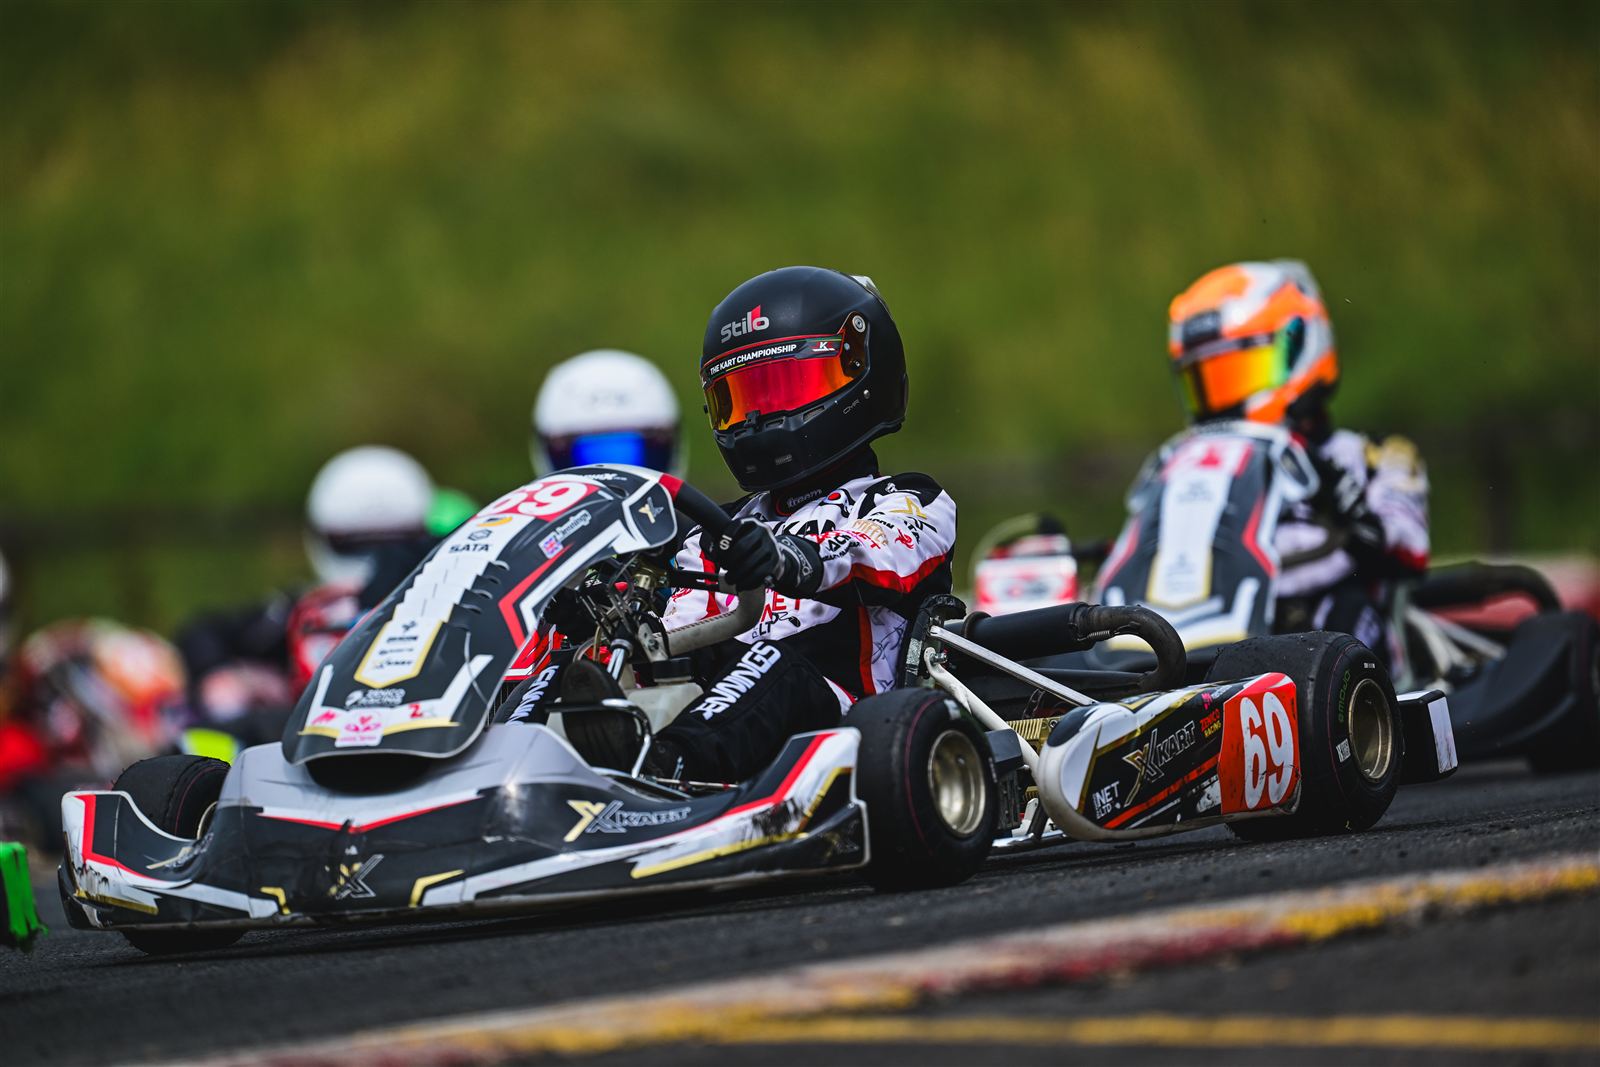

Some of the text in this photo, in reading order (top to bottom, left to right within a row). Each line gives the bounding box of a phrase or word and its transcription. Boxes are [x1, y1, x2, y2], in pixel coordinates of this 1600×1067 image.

[721, 305, 770, 344] Stilo
[710, 344, 797, 375] THE KART CHAMPIONSHIP
[476, 482, 588, 516] 69
[449, 544, 489, 553] SATA
[408, 703, 424, 719] 2
[1240, 692, 1294, 808] 69
